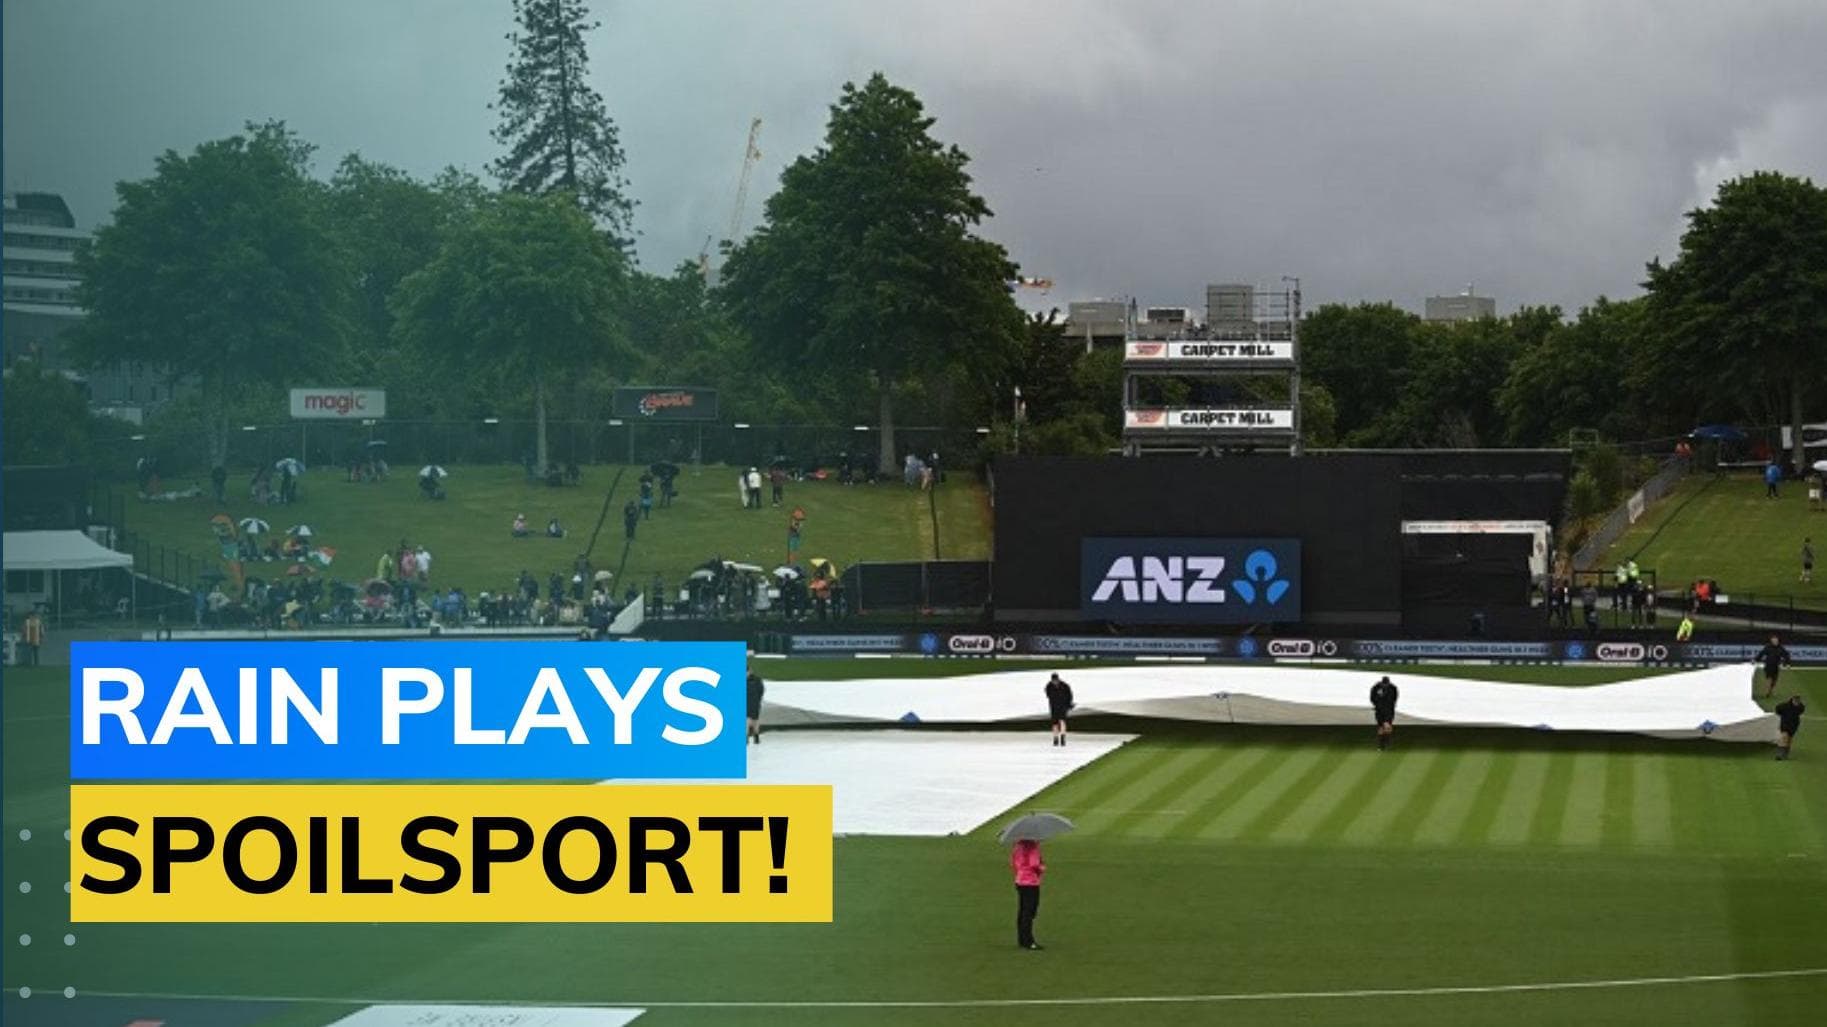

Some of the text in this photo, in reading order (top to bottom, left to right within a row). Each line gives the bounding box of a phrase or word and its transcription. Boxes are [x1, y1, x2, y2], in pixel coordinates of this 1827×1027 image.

[1180, 344, 1275, 357] CARPET MILL
[304, 391, 367, 415] magic
[1180, 412, 1274, 425] CARPET MILL
[1091, 556, 1226, 603] ANZ
[1600, 646, 1641, 658] Oral-B
